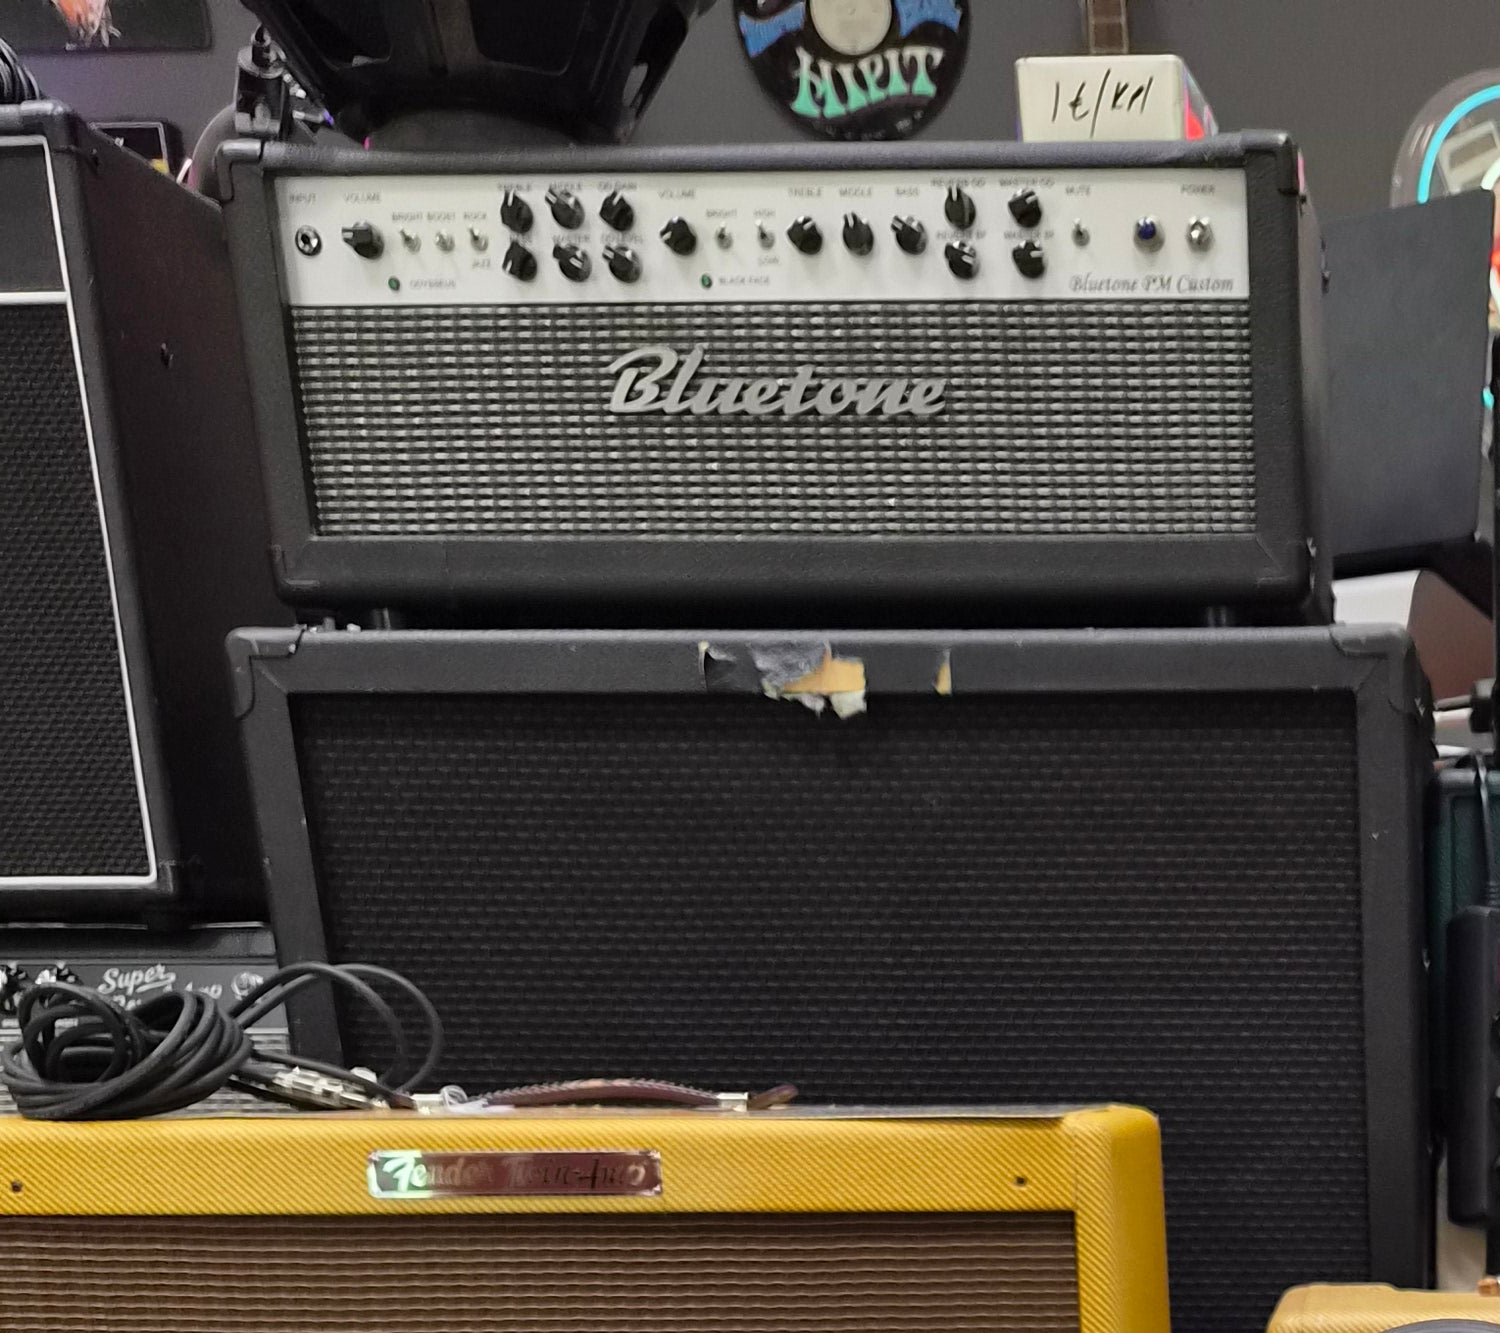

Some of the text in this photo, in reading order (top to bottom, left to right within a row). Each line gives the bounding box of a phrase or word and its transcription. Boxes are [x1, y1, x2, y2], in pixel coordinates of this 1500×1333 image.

[1069, 273, 1138, 293] Bluetone
[1176, 273, 1234, 293] Custom
[607, 343, 947, 416] Bluetone
[98, 963, 176, 996] Super
